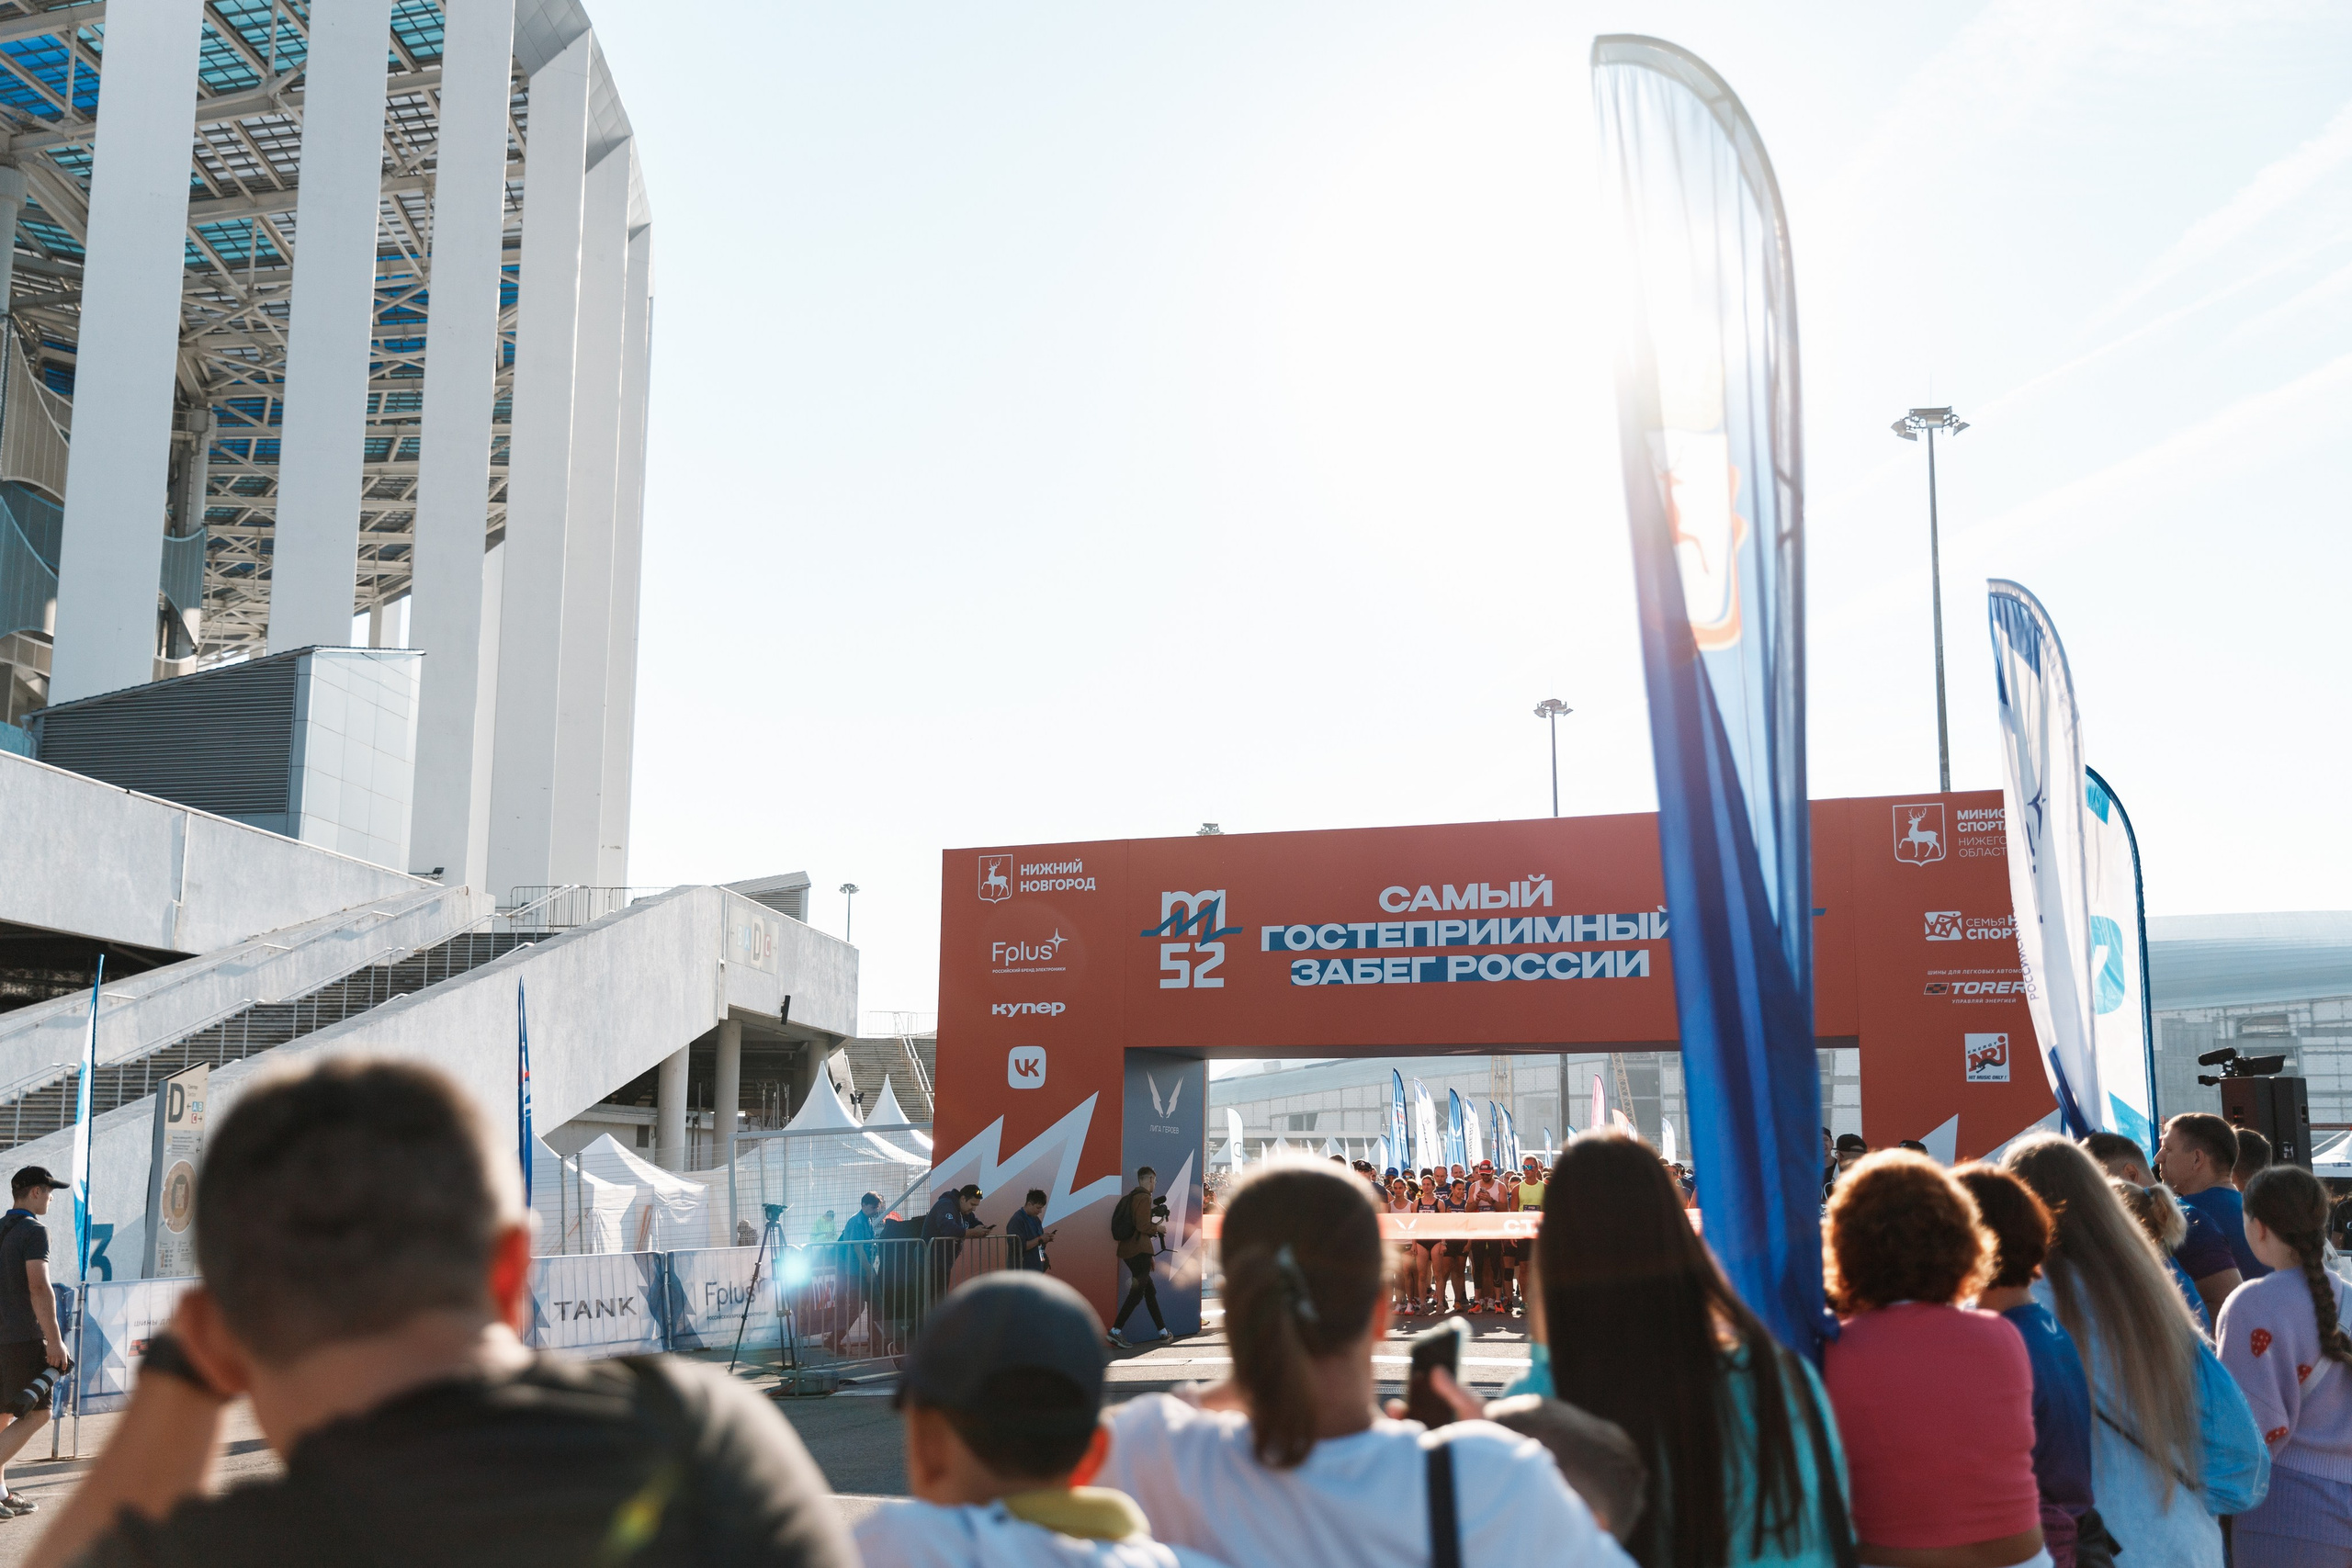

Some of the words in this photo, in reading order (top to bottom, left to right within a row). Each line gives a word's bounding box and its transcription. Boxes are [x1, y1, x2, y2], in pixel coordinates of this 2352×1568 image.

[1957, 820, 2006, 833] СПОРТ
[1958, 835, 2007, 846] НИЖЕГО
[1020, 858, 1083, 875] НИЖНИЙ
[1020, 876, 1096, 893] НОВГОРОД
[1379, 874, 1553, 912] САМЫЙ
[1261, 905, 1670, 952] ГОСТЕПРИИМНЫЙ
[1966, 918, 2006, 927] СЕМЬЯ
[753, 922, 762, 961] D
[992, 941, 1054, 966] Fplus
[1159, 942, 1226, 989] 52
[1291, 955, 1436, 987] ЗАБЕГ
[1447, 949, 1650, 983] РОССИИ
[1967, 1041, 1997, 1055] ENERGY
[1014, 1058, 1040, 1077] VK
[168, 1082, 186, 1123] D
[1149, 1124, 1161, 1133] ЛИГА
[1162, 1125, 1180, 1134] ГЕРОЕВ
[1503, 1219, 1539, 1233] СТ
[706, 1280, 755, 1312] Fplus
[553, 1296, 638, 1321] TANK
[133, 1319, 157, 1327] ШИНЫ
